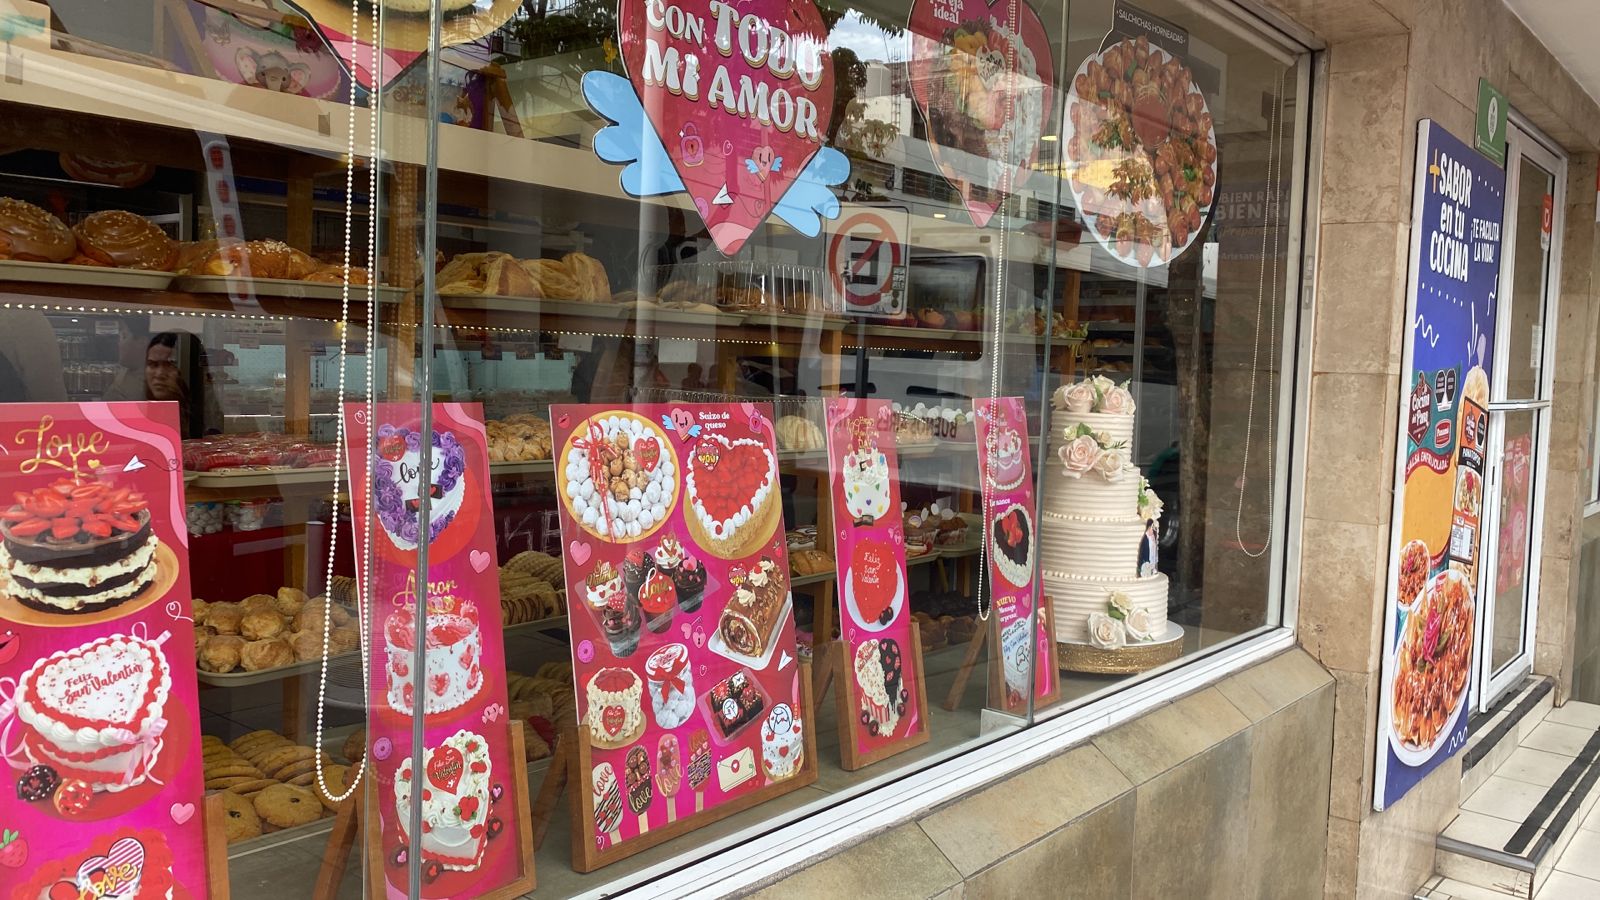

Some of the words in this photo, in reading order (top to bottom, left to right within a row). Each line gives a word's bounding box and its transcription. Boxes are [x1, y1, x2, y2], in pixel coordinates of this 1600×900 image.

[933, 3, 959, 24] ideal
[1118, 9, 1152, 32] SALCHICHAS
[1152, 24, 1184, 45] HORNEADAS
[644, 0, 704, 48] CON
[709, 0, 822, 91] TODO
[642, 38, 700, 100] MI
[708, 65, 818, 142] AMOR
[1215, 203, 1262, 221] BIEN
[1440, 202, 1453, 235] en
[1454, 201, 1465, 240] tu
[1429, 230, 1469, 283] COCINA
[704, 422, 726, 431] queso
[721, 411, 730, 420] de
[15, 415, 110, 477] Love
[397, 458, 440, 484] lo
[64, 673, 93, 688] Feliz
